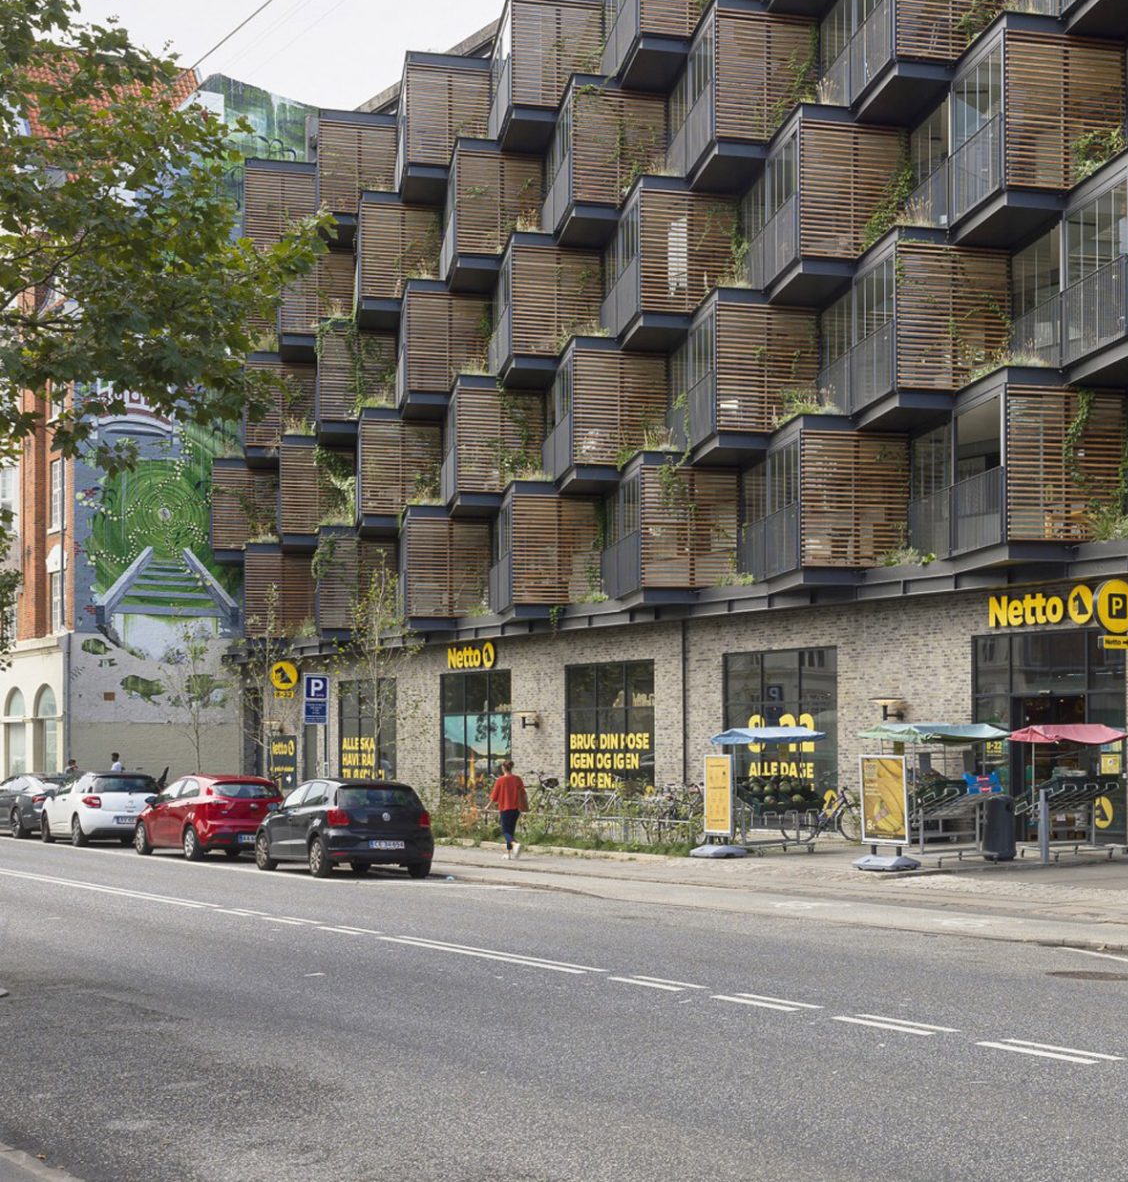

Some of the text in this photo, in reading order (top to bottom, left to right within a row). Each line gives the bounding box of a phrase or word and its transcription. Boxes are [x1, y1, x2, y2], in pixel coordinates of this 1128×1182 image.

[988, 593, 1064, 627] Netto
[1112, 597, 1123, 616] P
[447, 646, 481, 669] Netto
[311, 679, 324, 697] P
[342, 737, 359, 750] ALLE
[600, 733, 618, 749] DIN
[570, 753, 639, 769] IGEN OG IGEN
[749, 761, 778, 777] ALLE
[570, 772, 586, 787] OG
